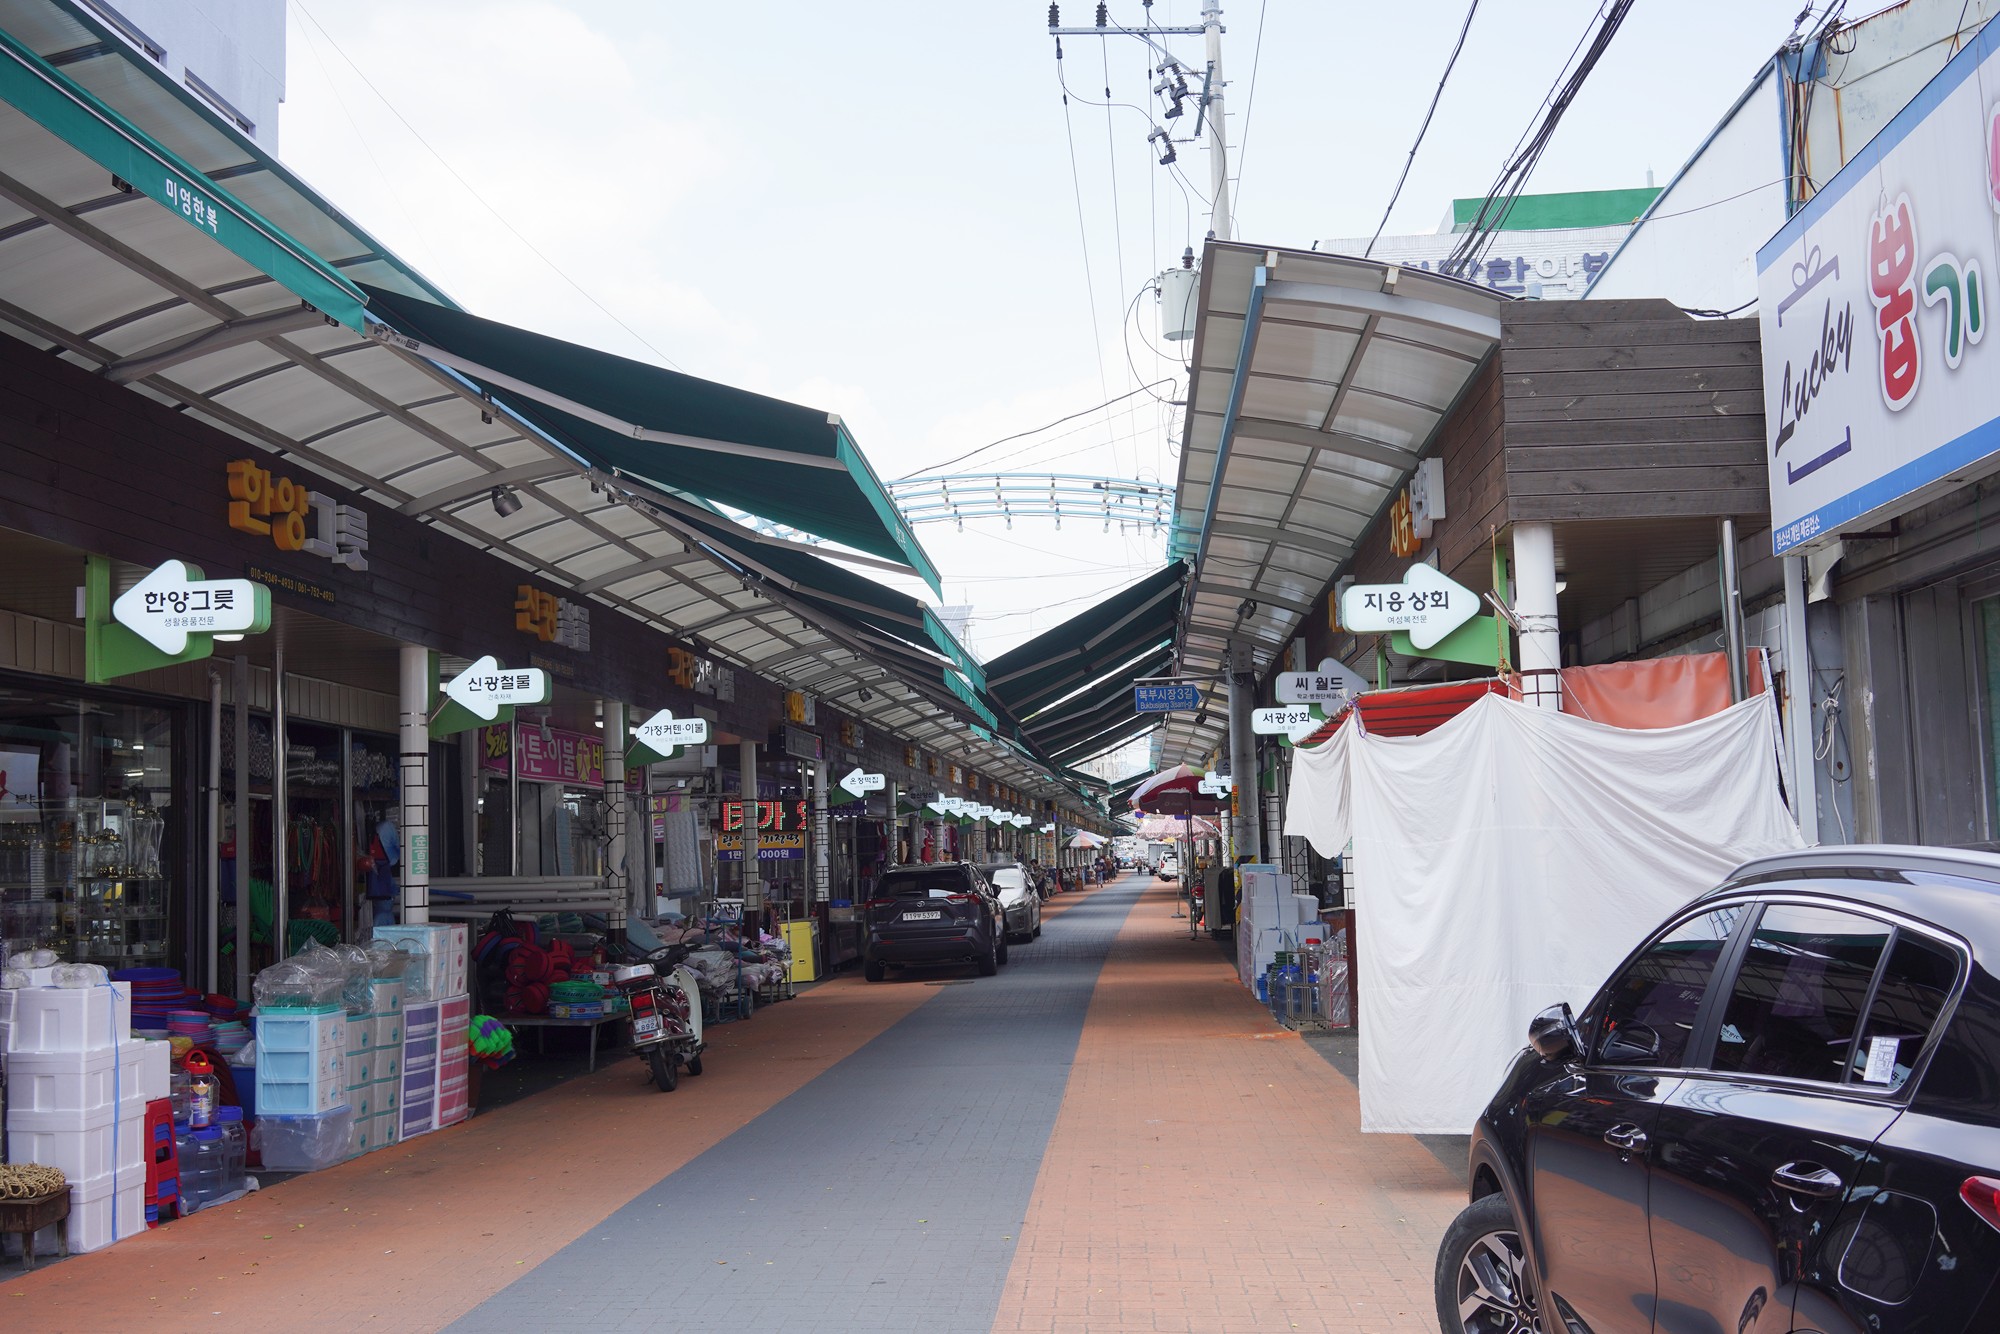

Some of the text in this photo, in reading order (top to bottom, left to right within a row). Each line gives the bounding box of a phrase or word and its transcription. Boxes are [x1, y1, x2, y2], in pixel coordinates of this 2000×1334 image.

[166, 178, 218, 234] 미영한복
[1775, 297, 1854, 458] Lucky
[227, 459, 368, 571] 한양그릇
[144, 589, 234, 614] 한양그릇
[164, 615, 215, 627] 생활용품전문
[1387, 614, 1428, 625] 여성복전문
[468, 674, 531, 692] 신광철물
[1139, 687, 1193, 701] 북부시장3길
[1262, 711, 1310, 725] 서광상회
[1518, 1309, 1531, 1324] KIA
